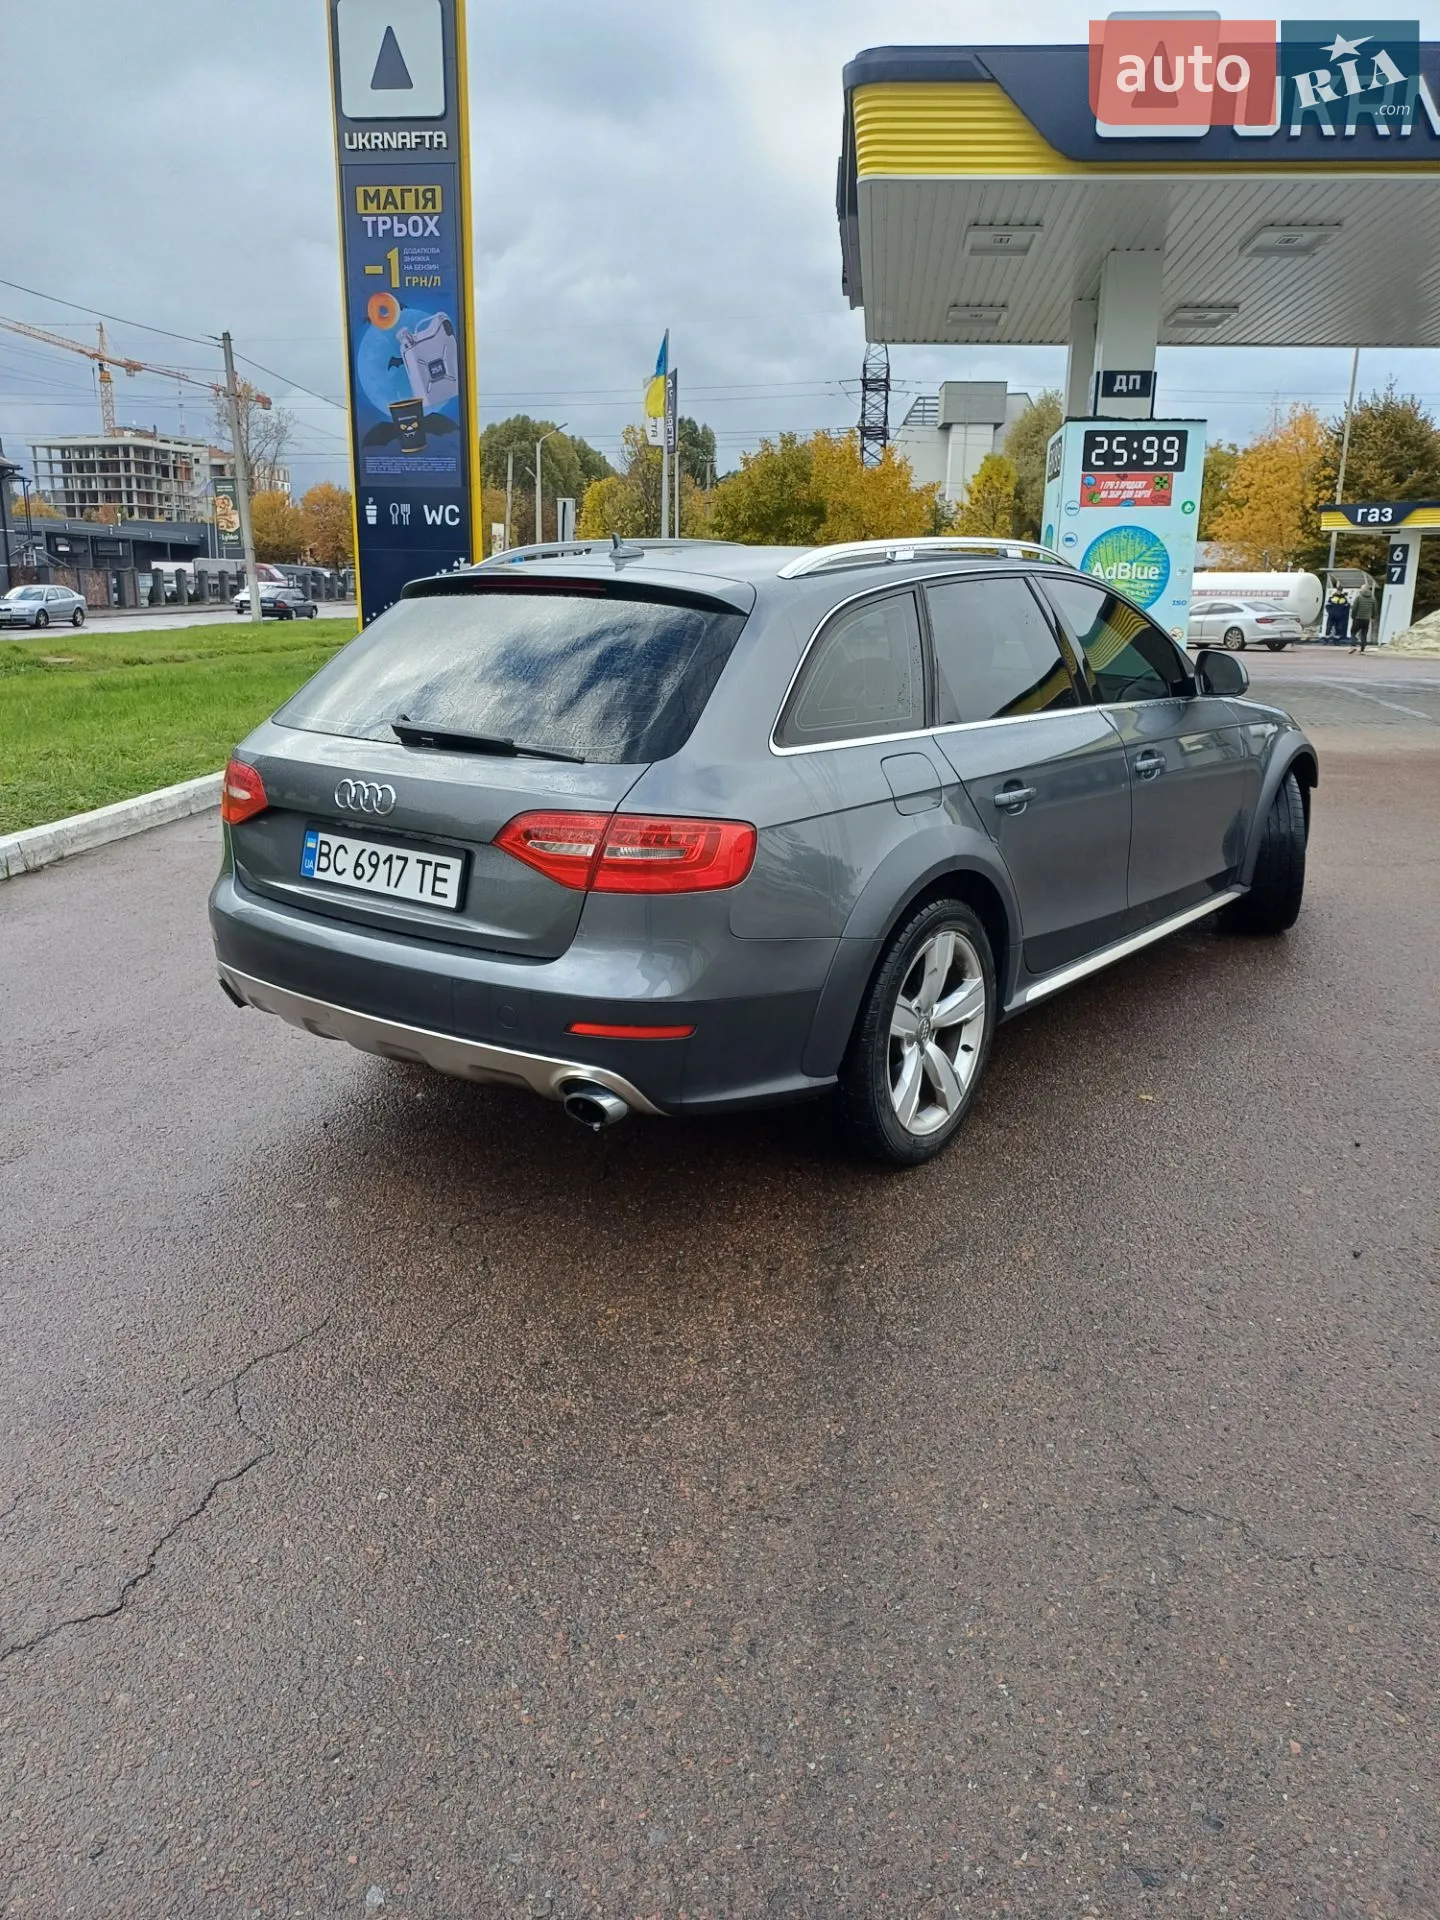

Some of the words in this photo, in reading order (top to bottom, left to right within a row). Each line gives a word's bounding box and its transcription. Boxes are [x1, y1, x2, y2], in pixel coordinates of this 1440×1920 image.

[344, 131, 447, 149] UKRNAFTA
[363, 188, 437, 210] МАГІЯ
[362, 216, 440, 237] ТРЬОХ
[405, 276, 441, 288] ГРН/Л
[1113, 374, 1141, 392] ДП
[423, 504, 460, 526] WC
[1356, 507, 1393, 522] газ
[1392, 547, 1403, 561] 6
[1091, 562, 1160, 580] AdBlue
[1391, 567, 1401, 582] 7
[304, 858, 314, 869] UA
[316, 840, 348, 876] BC
[353, 848, 408, 888] 6917
[416, 858, 451, 898] TE
